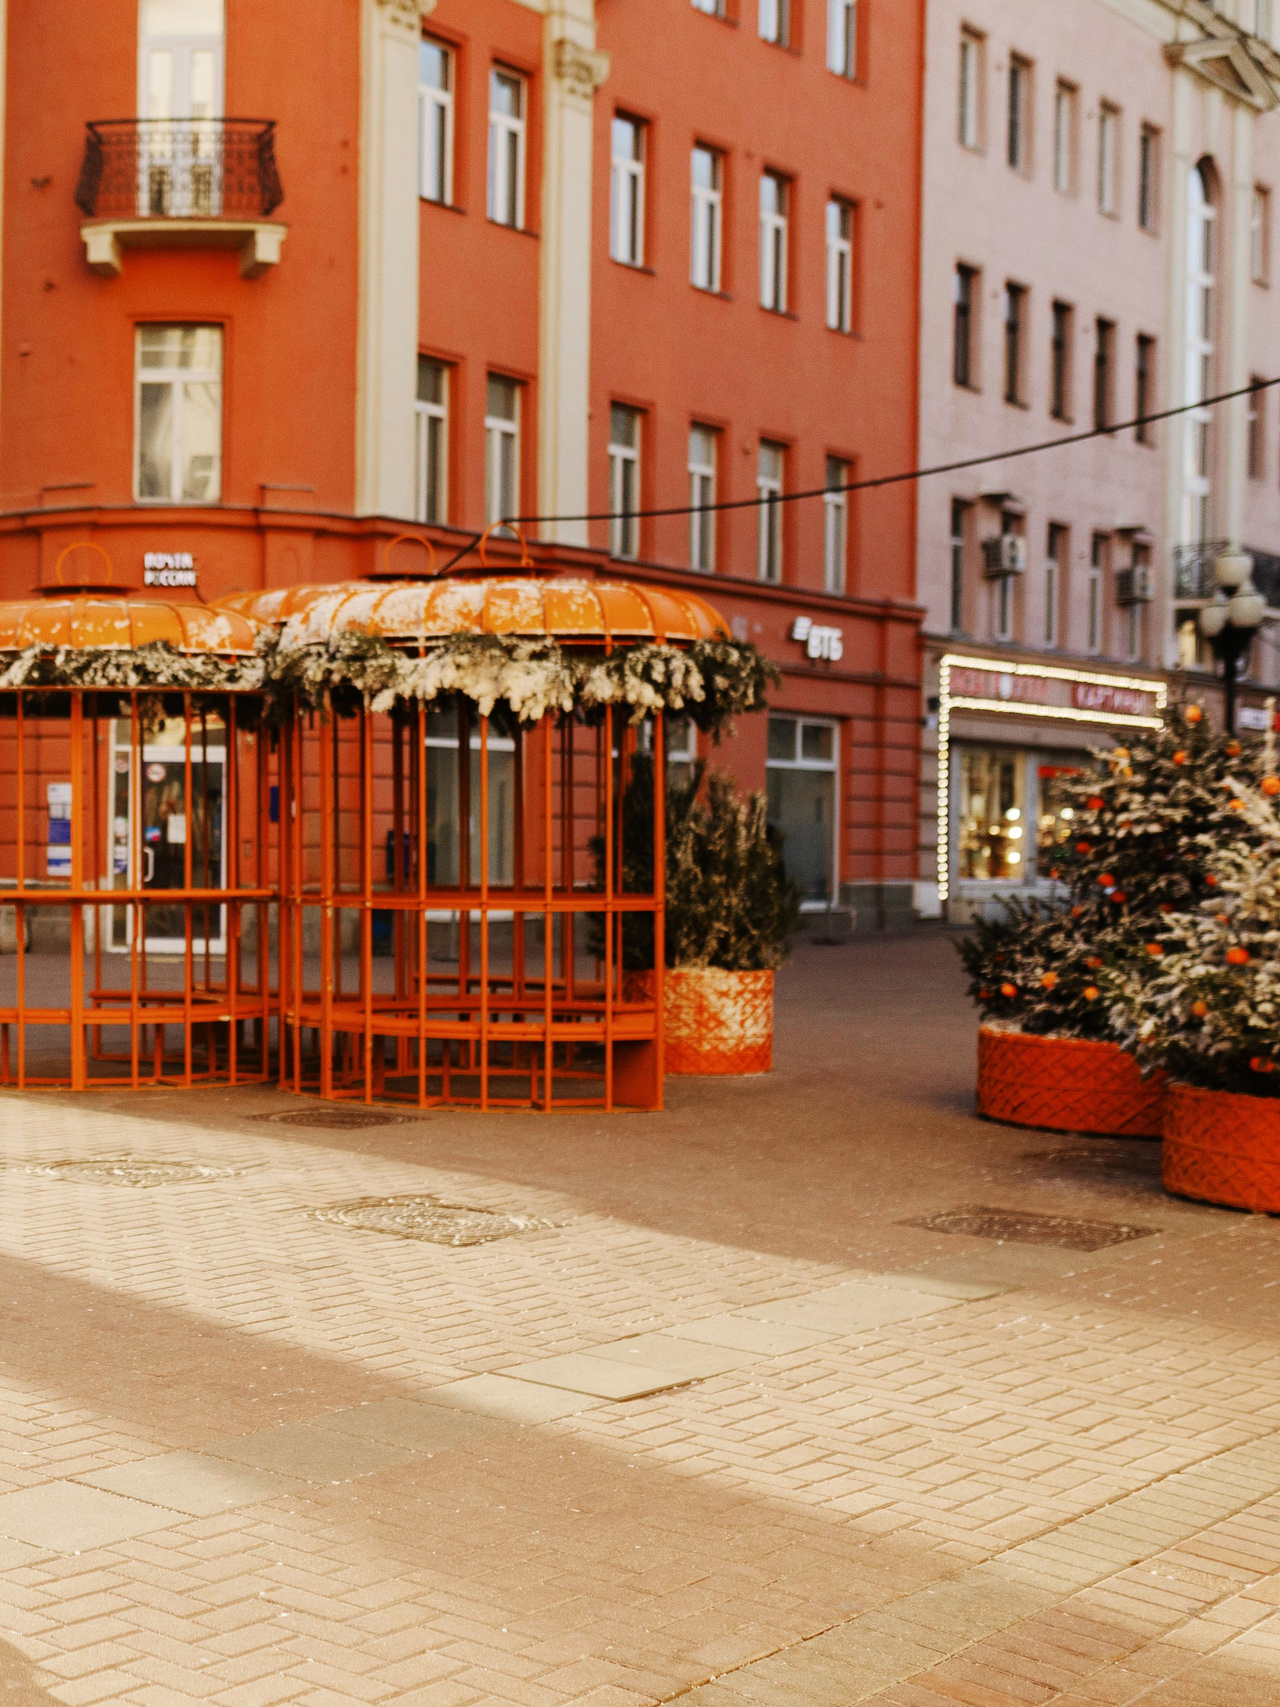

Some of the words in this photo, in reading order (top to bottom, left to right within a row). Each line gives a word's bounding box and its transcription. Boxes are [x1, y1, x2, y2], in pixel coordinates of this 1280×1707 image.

[144, 552, 194, 569] ПОЧТА
[144, 570, 197, 587] РОССИИ
[807, 625, 843, 661] ВТБ
